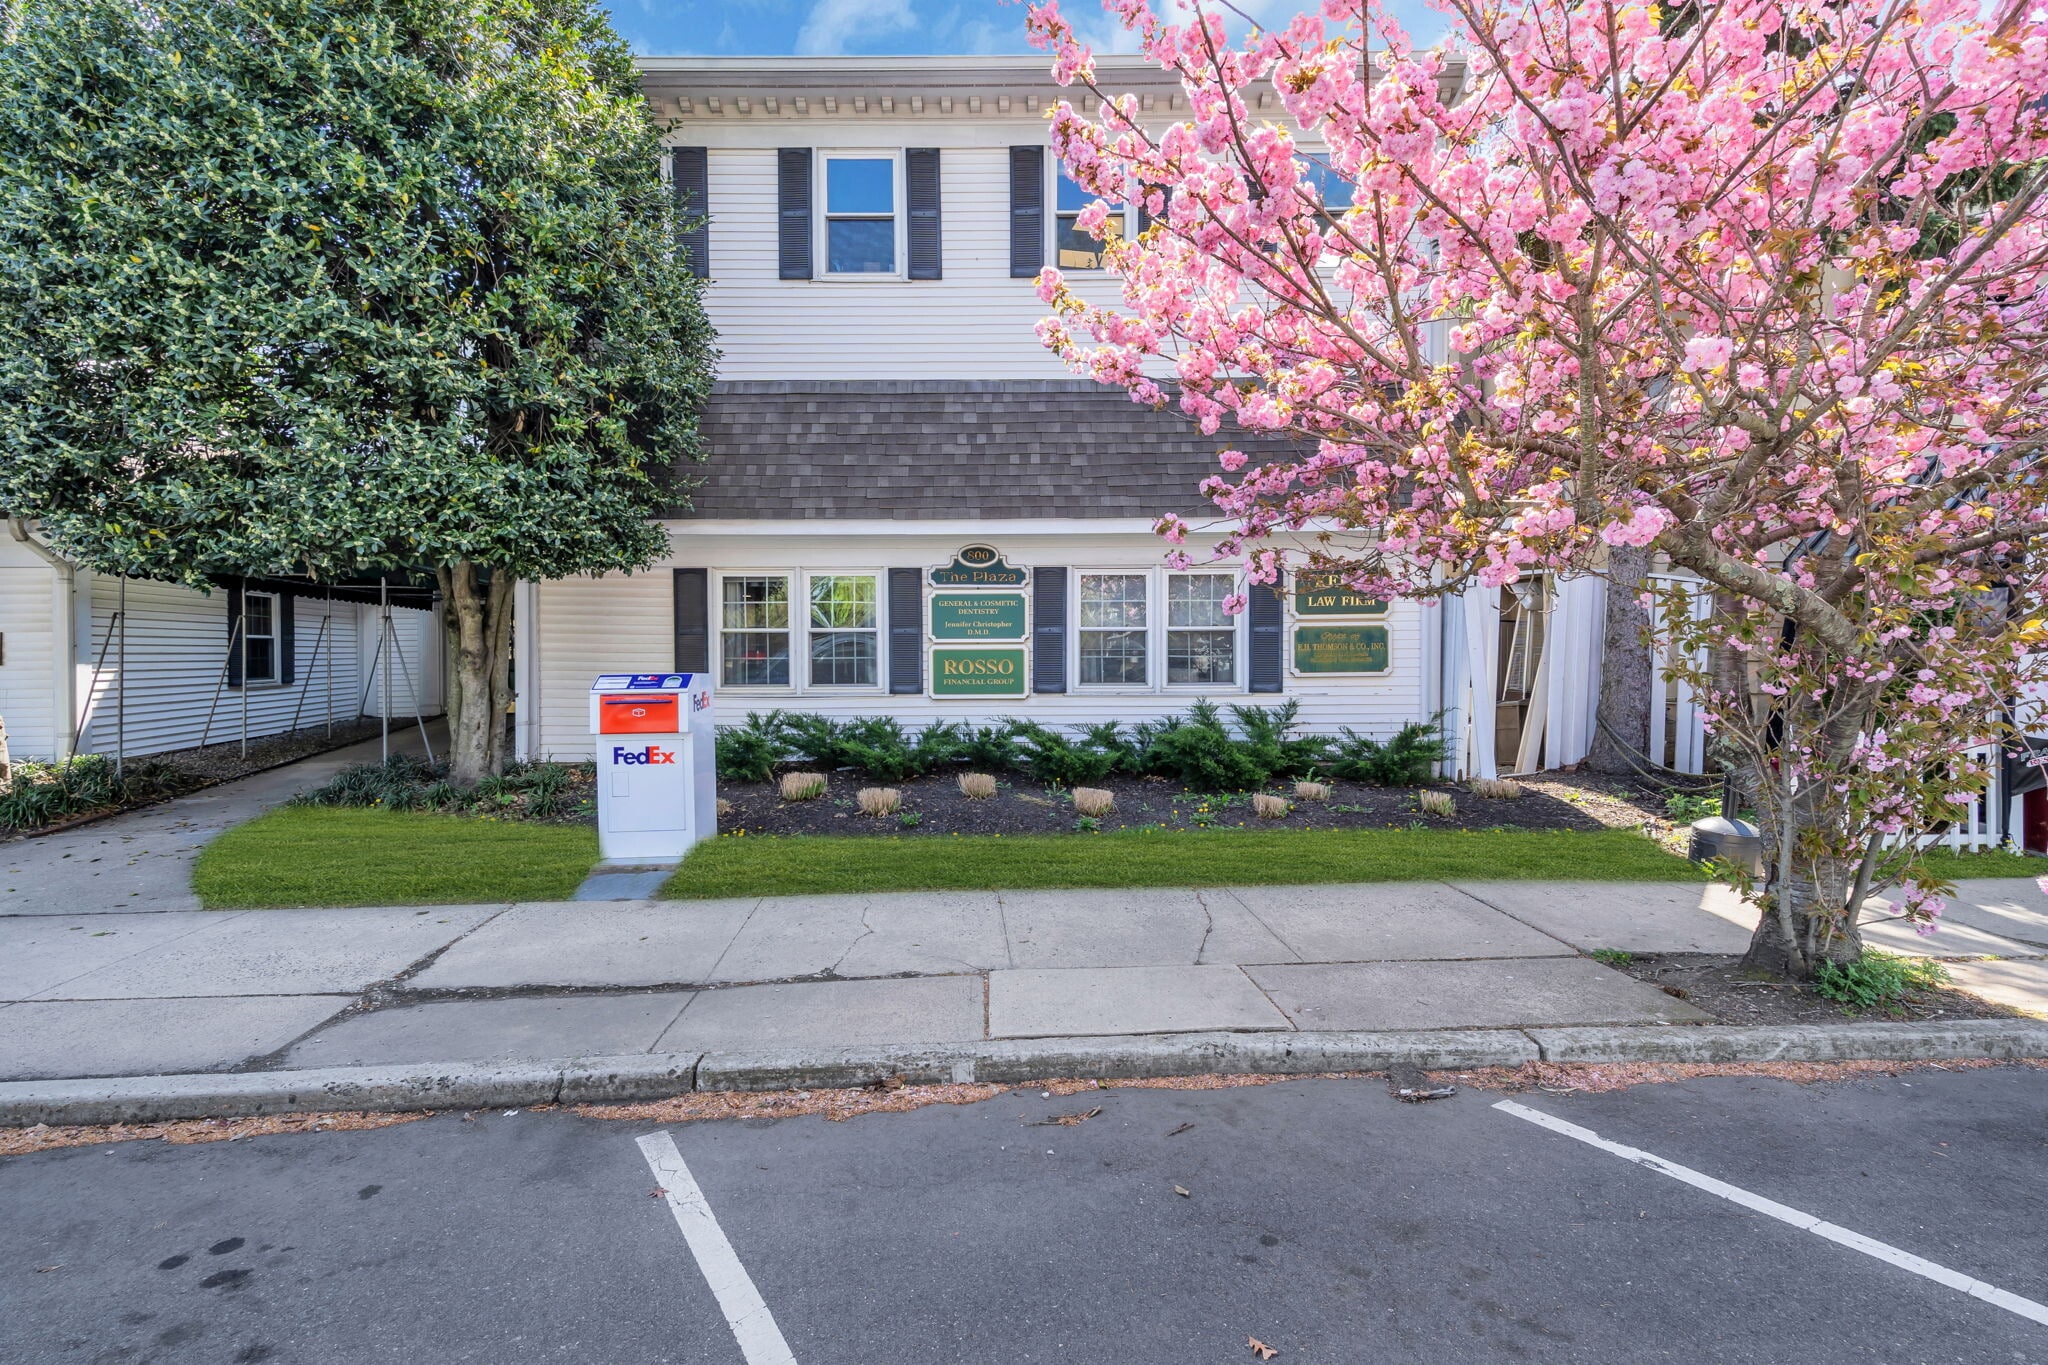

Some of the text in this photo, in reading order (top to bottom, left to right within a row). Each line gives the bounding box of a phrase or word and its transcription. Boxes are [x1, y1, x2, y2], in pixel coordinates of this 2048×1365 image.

[940, 571, 1016, 582] The Plaza
[1307, 595, 1336, 607] LAW
[972, 621, 1013, 629] Christopher
[943, 658, 1014, 675] ROSSO
[693, 691, 710, 712] FedEx
[613, 746, 675, 765] FedEx
